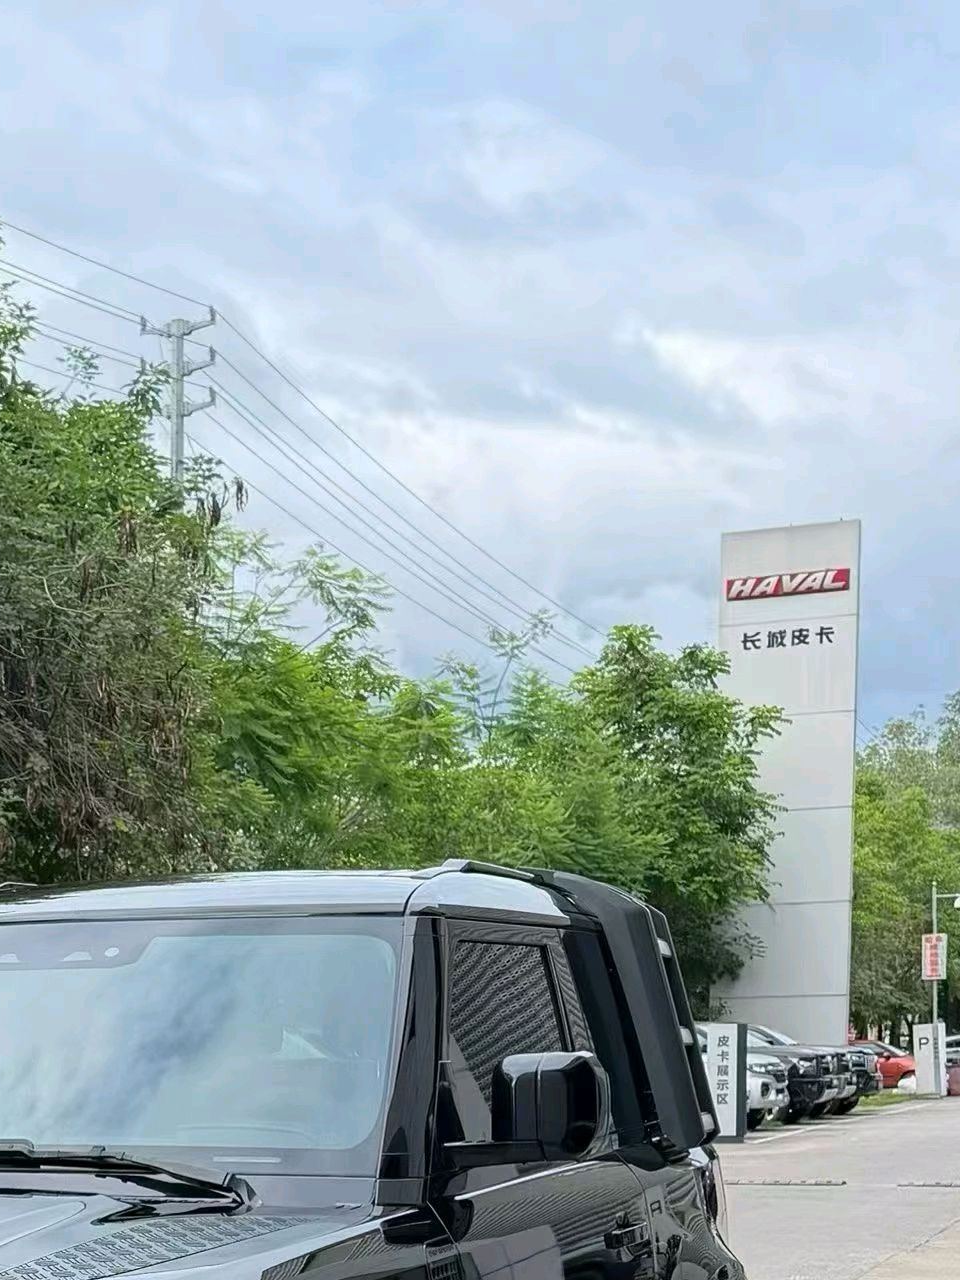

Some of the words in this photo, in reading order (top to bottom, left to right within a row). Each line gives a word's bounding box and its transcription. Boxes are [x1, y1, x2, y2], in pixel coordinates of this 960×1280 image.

[728, 570, 847, 599] HAVAL
[741, 625, 835, 650] 长城皮卡
[919, 1036, 930, 1051] P
[716, 1034, 730, 1105] 皮卡展示区
